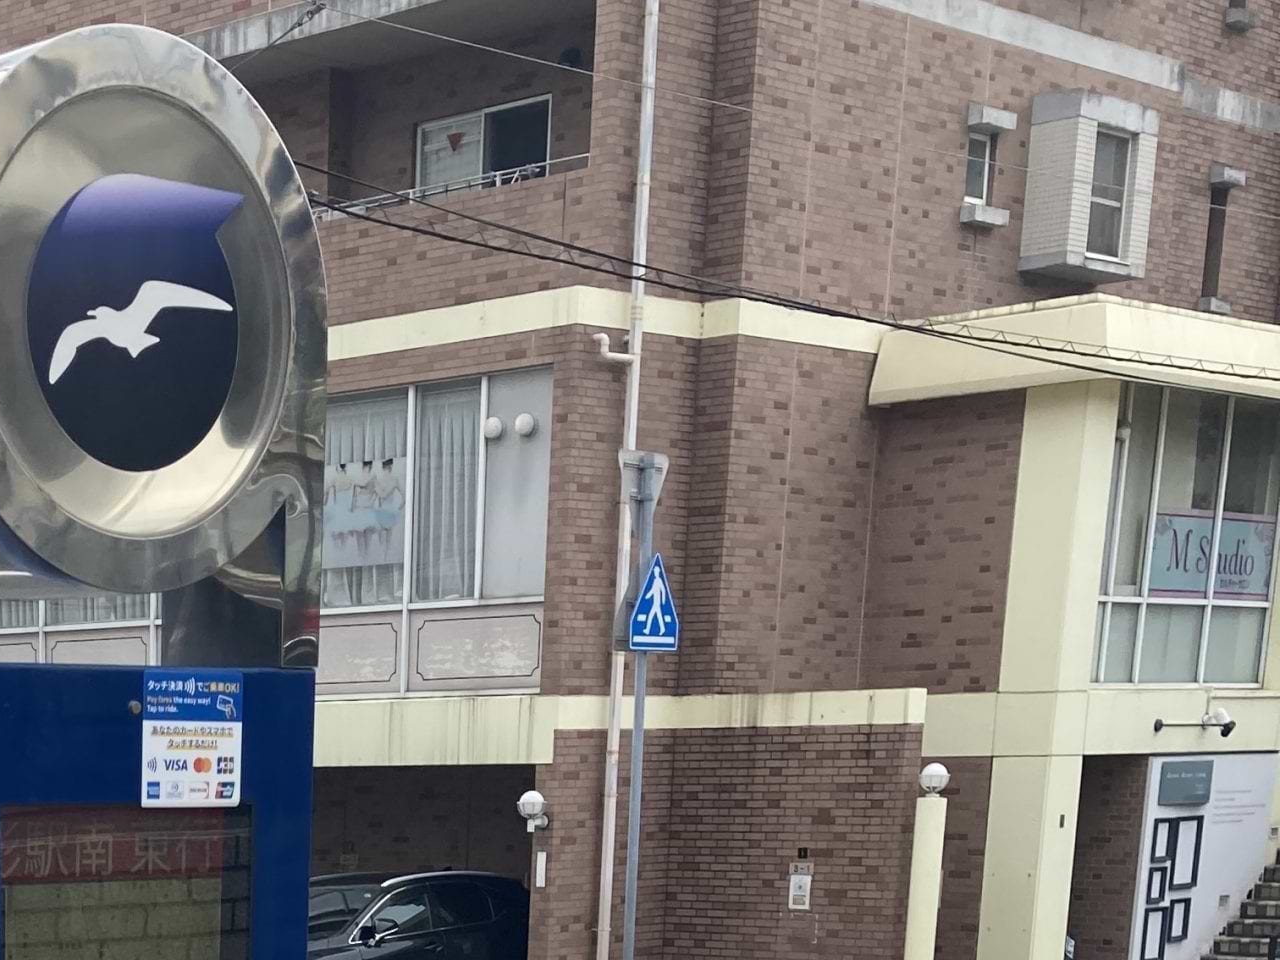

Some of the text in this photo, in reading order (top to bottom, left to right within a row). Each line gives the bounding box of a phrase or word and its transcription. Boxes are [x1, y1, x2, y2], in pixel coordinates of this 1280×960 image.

[1166, 528, 1255, 576] M Sudio
[164, 759, 188, 771] VISA
[130, 820, 220, 875] 東行
